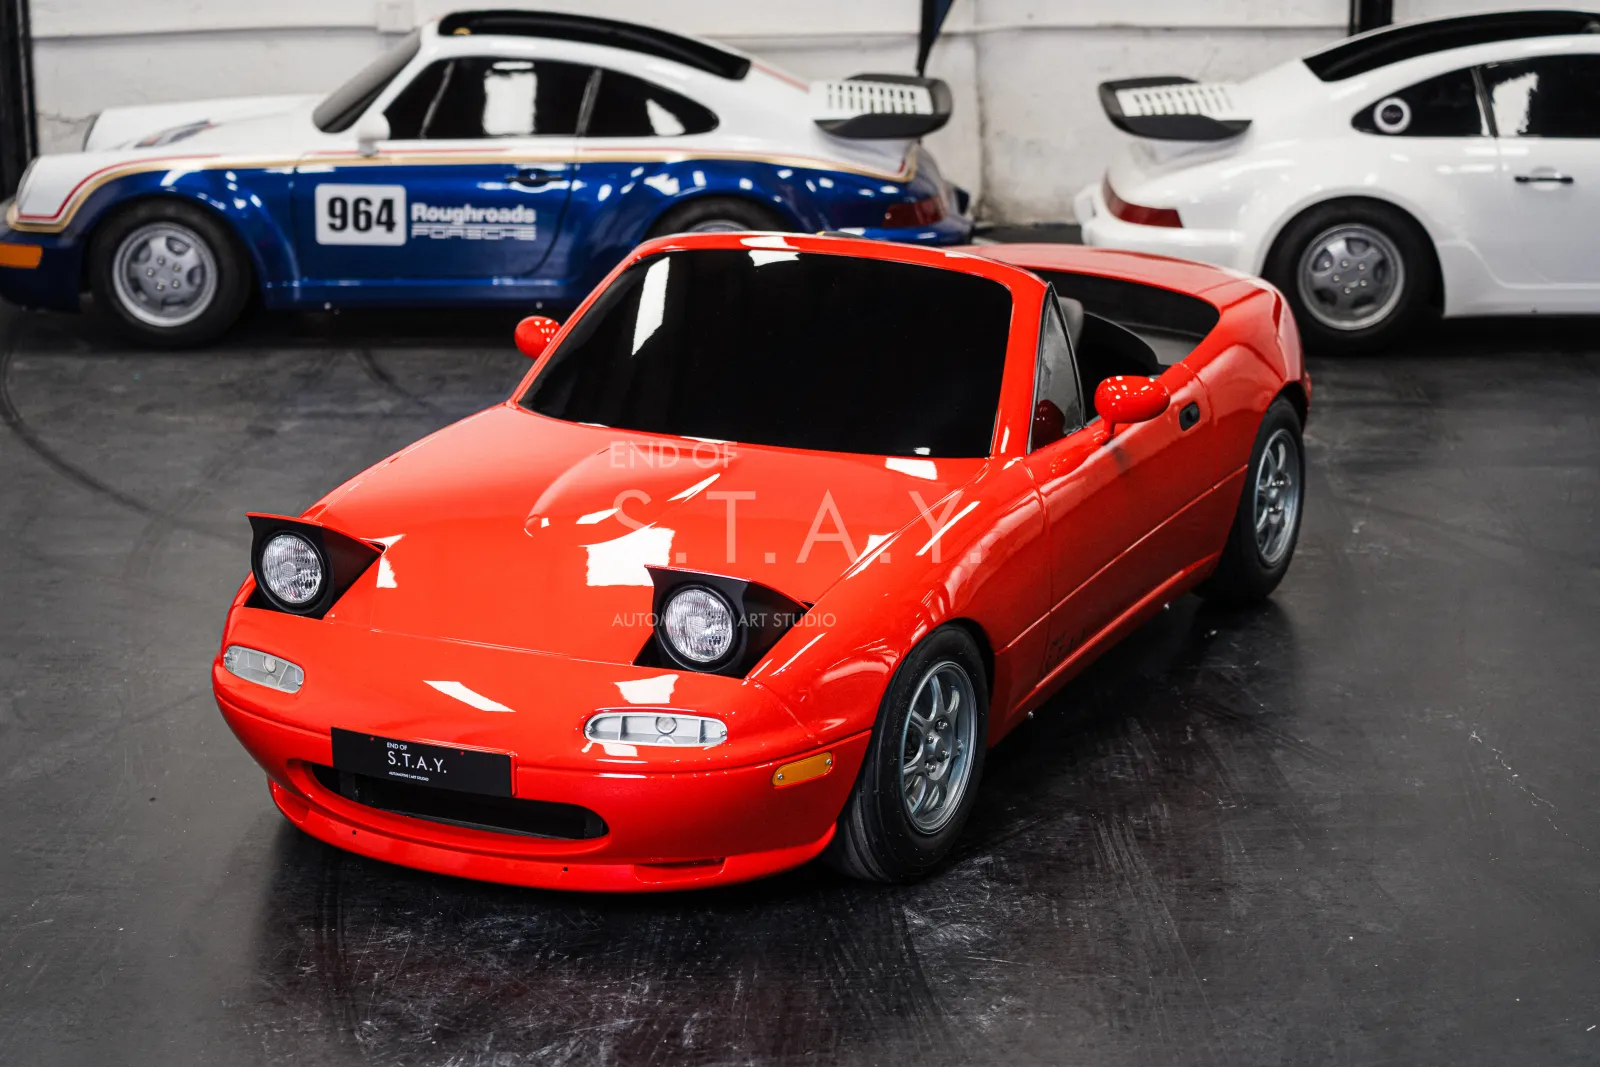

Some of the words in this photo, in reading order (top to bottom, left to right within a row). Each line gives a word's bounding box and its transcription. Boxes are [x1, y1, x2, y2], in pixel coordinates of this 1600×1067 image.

[328, 197, 396, 233] 964
[411, 202, 536, 225] Roughroads
[411, 223, 536, 241] PORSCHE
[387, 742, 399, 750] END
[387, 750, 447, 774] S.T.A.Y.
